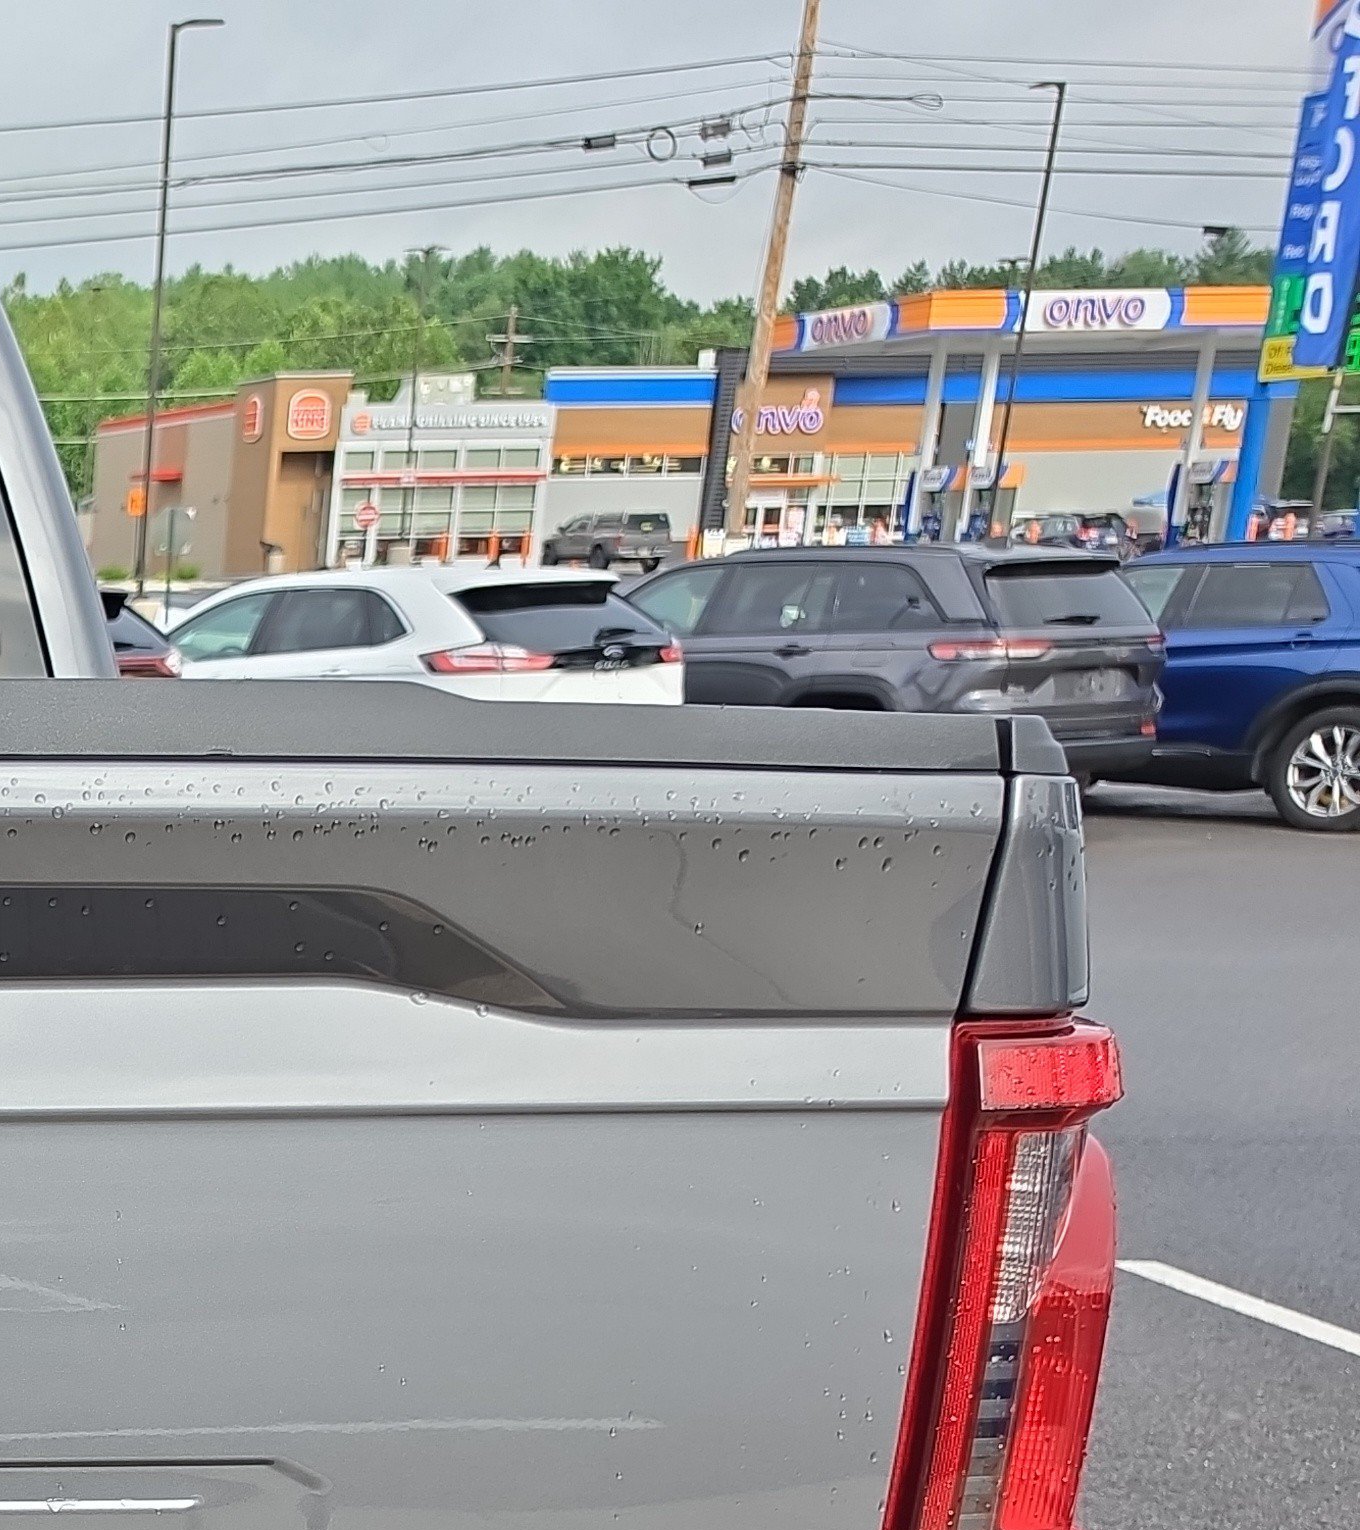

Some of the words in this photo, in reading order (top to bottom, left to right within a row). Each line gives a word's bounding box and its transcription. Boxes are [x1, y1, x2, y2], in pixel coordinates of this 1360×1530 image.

[809, 307, 871, 346] onvo
[1044, 295, 1147, 328] onvo
[1211, 403, 1244, 432] Fly
